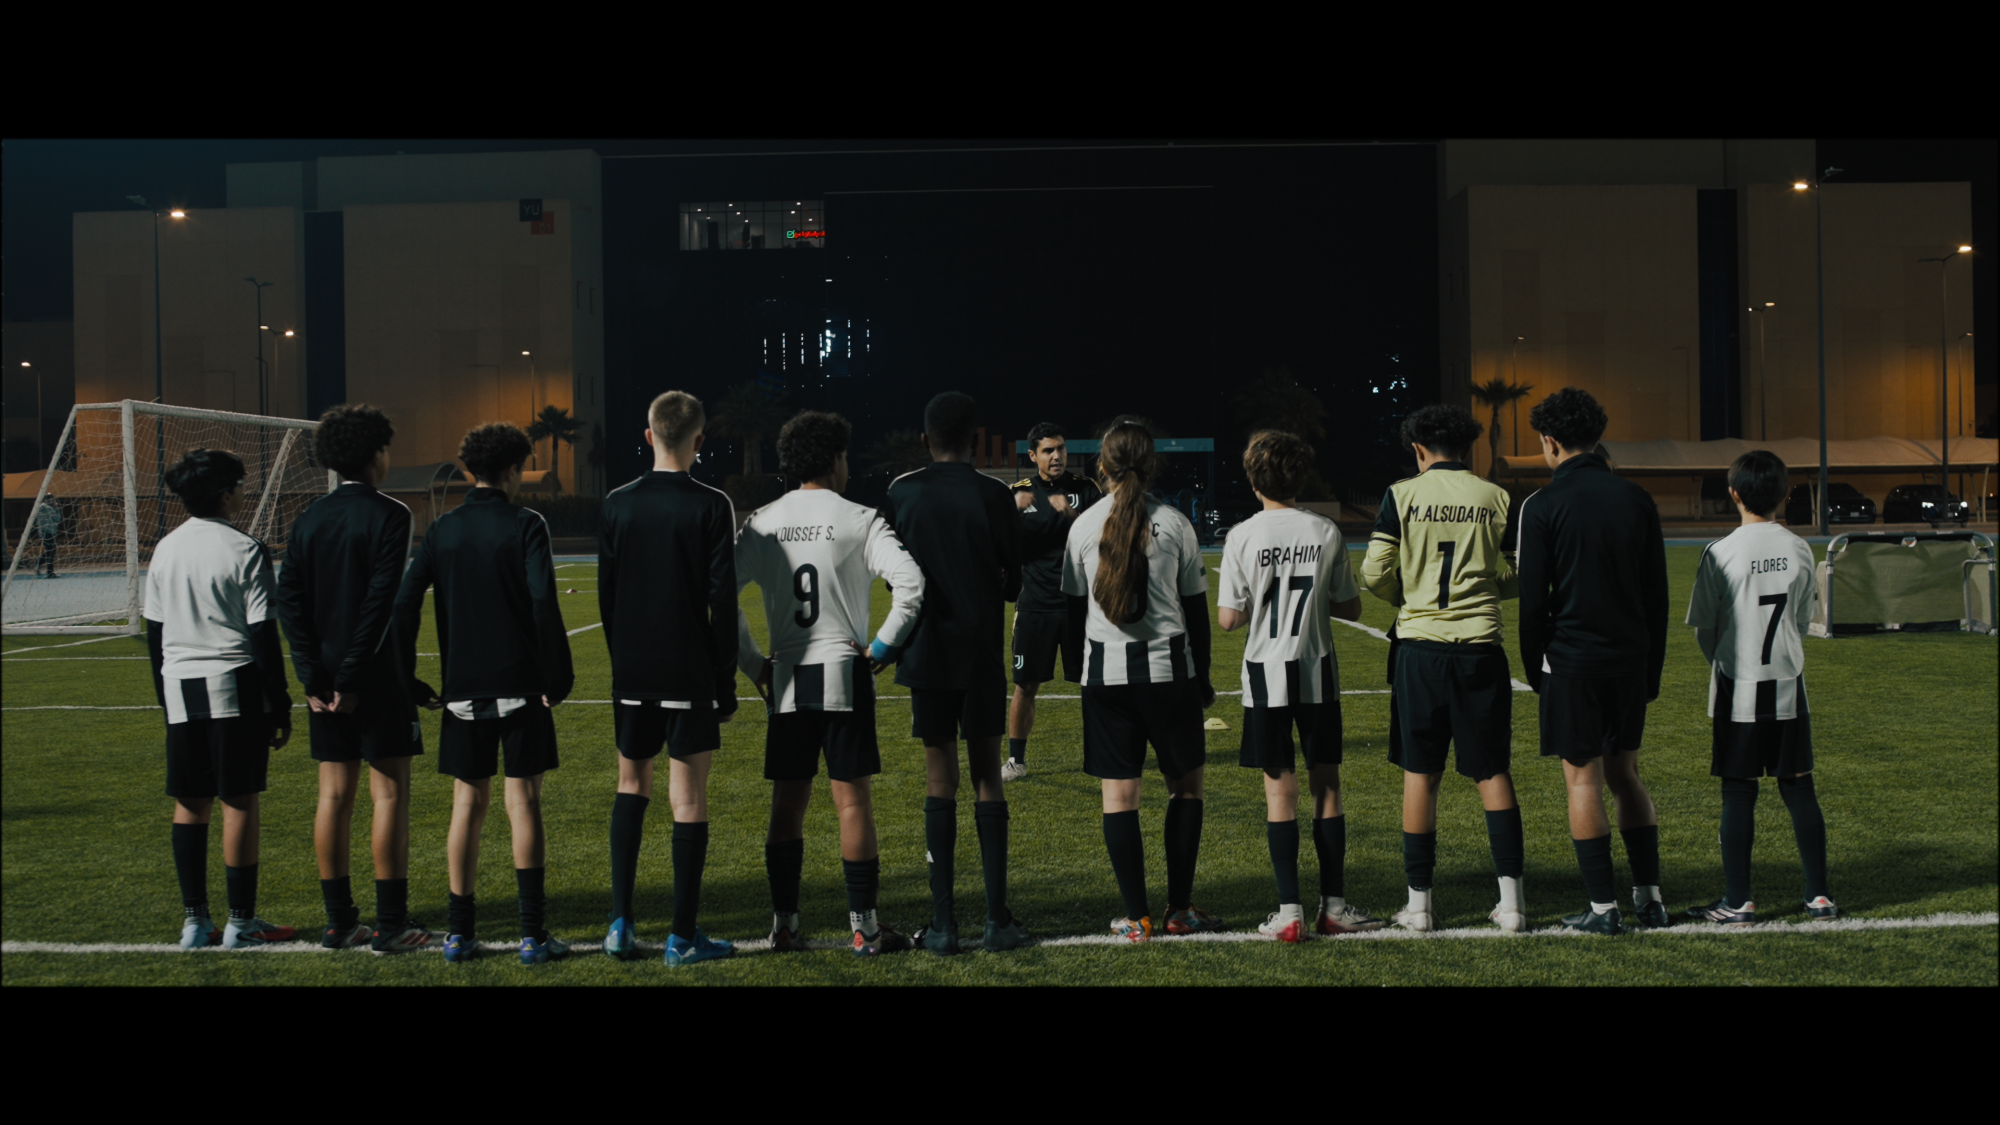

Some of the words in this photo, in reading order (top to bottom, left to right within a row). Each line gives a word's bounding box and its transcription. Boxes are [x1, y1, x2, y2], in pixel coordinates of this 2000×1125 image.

[523, 204, 540, 216] YU
[539, 223, 552, 234] 01
[1408, 505, 1497, 525] M.ALSUDAIRY
[826, 525, 836, 541] S.
[1257, 545, 1322, 567] IBRAHIM
[1751, 557, 1788, 574] FLORES
[1437, 541, 1456, 610] 1
[794, 563, 819, 628] 9
[1262, 575, 1314, 639] 17
[1758, 593, 1788, 665] 7
